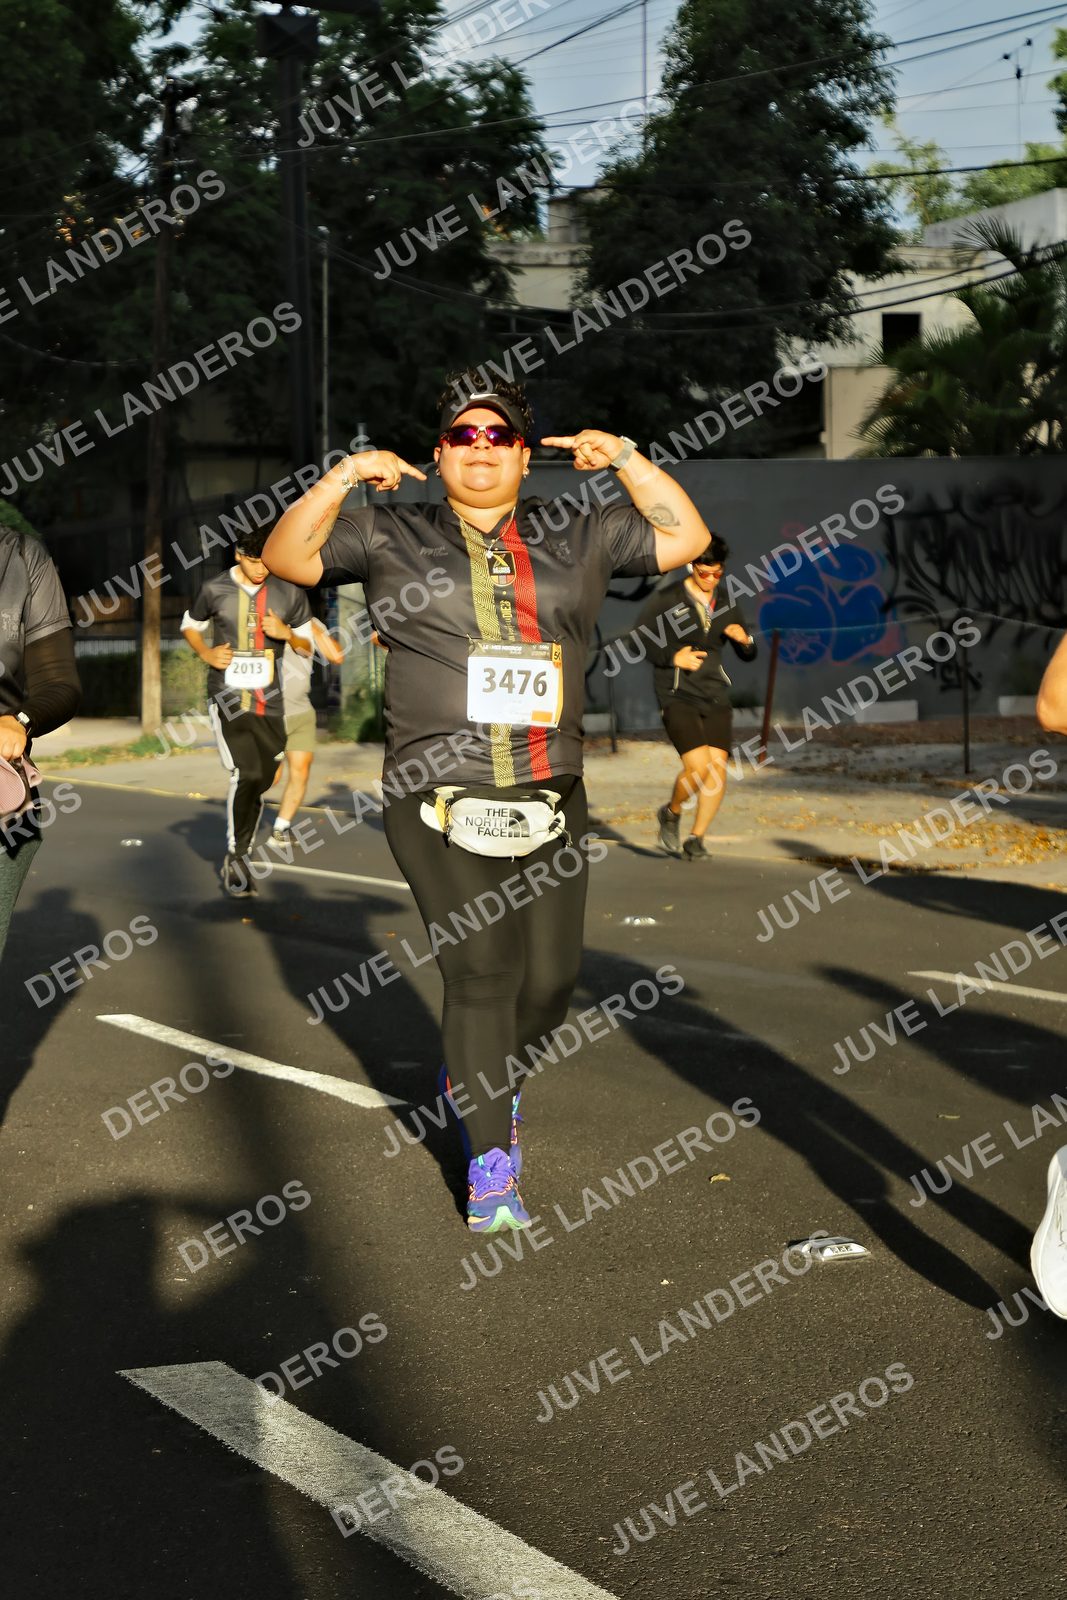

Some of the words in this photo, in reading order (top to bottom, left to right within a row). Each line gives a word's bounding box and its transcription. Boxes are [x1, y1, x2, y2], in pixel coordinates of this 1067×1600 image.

[232, 662, 263, 674] 2013
[482, 667, 547, 697] 3476
[485, 808, 509, 818] THE
[465, 817, 508, 828] NORTH
[477, 827, 508, 838] FACE
